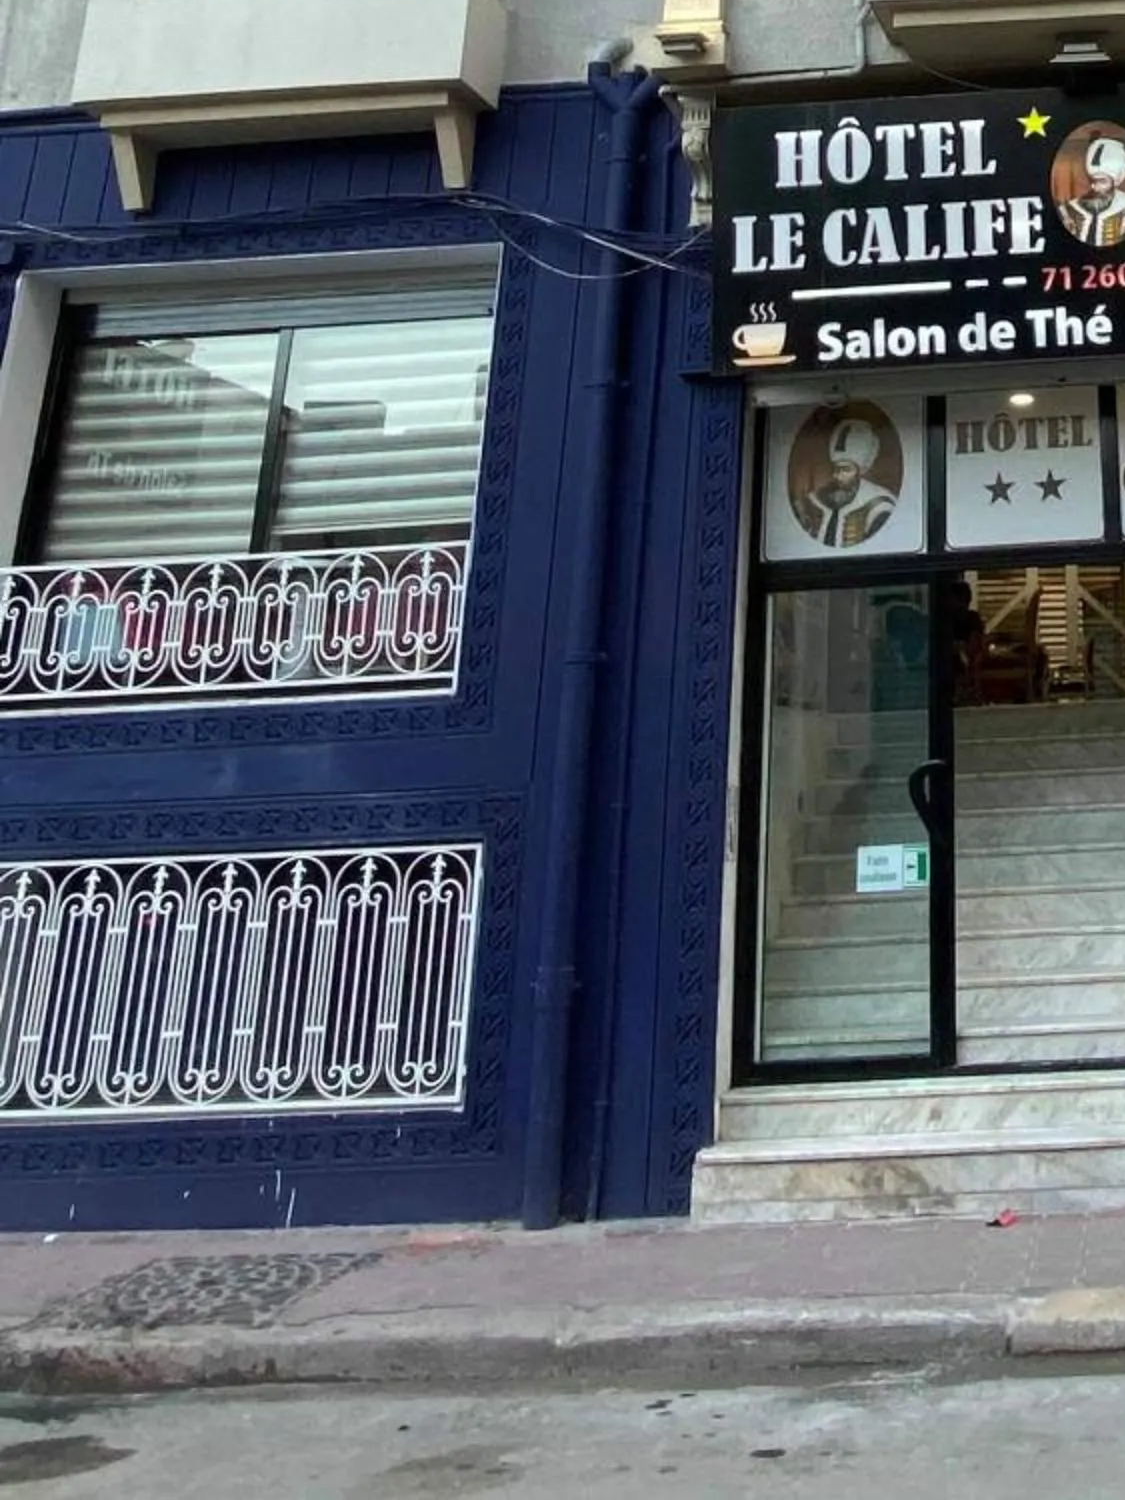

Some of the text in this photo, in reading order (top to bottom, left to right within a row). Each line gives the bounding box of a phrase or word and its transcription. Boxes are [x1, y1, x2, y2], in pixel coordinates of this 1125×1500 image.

[774, 117, 997, 188] HÔTEL
[731, 196, 1046, 273] LE CALIFE
[1041, 267, 1072, 292] 71
[817, 304, 1113, 361] Salon de Thé
[955, 413, 1093, 455] HÔTEL
